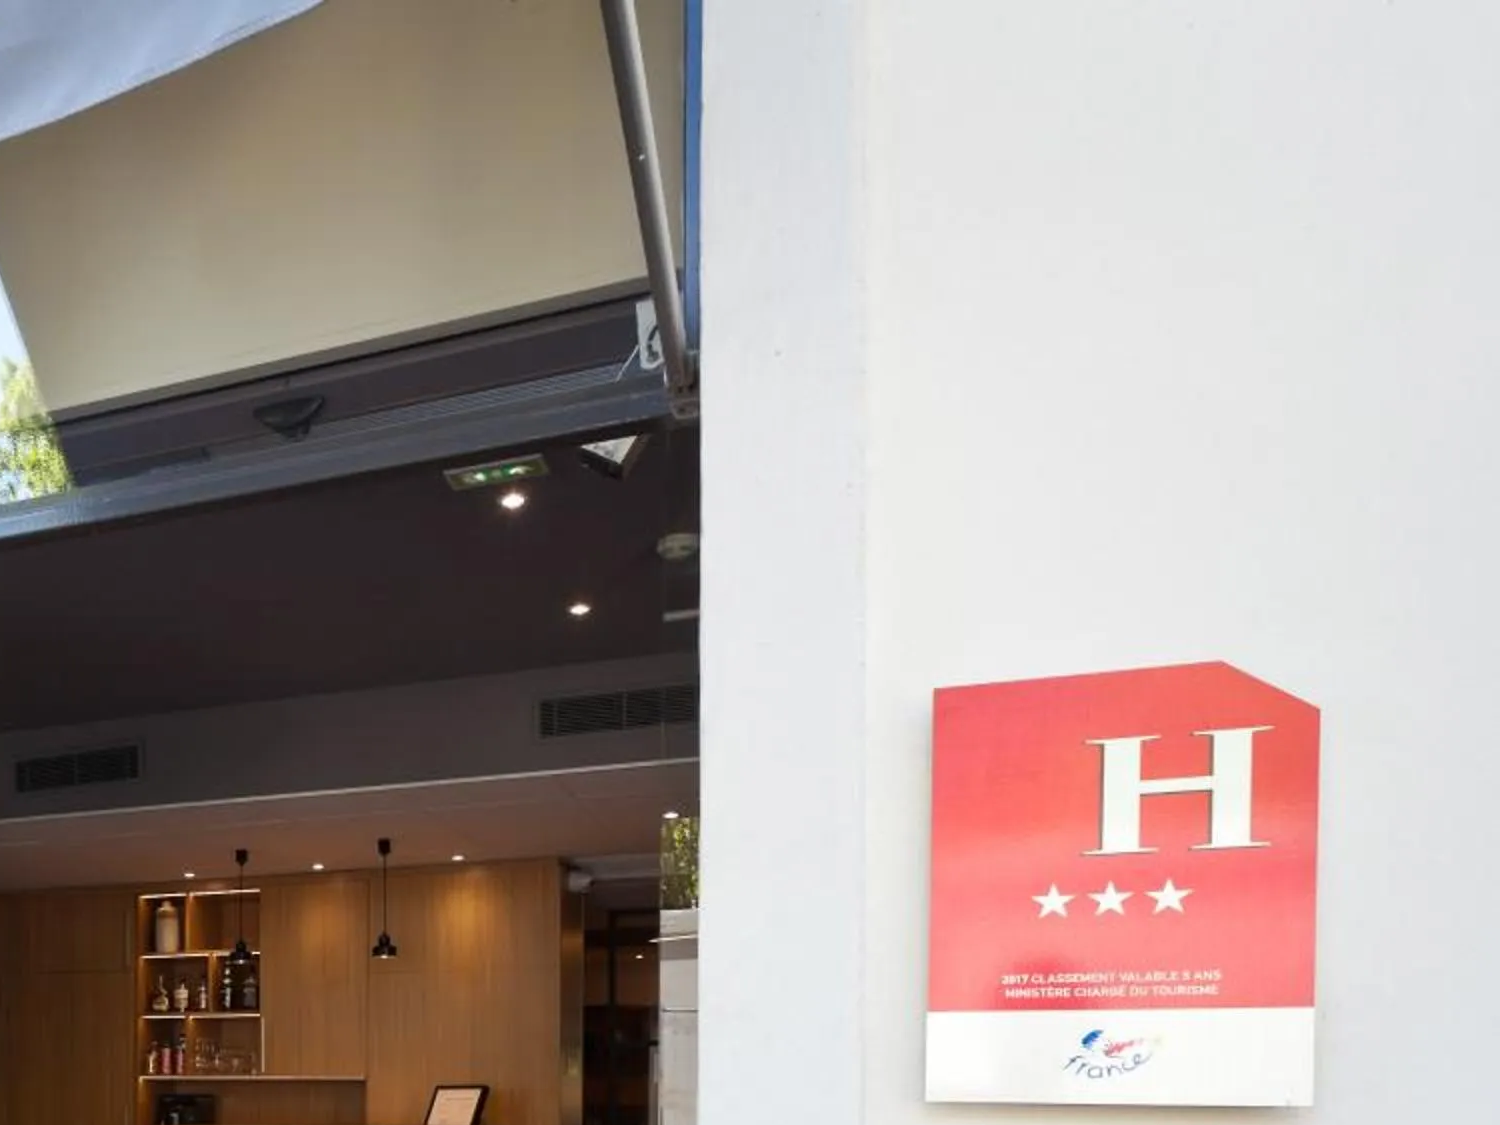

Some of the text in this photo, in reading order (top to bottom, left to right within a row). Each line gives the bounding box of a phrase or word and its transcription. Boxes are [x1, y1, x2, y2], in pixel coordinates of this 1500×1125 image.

[1081, 725, 1275, 855] H
[1030, 972, 1115, 984] CLASSEMENT
[1118, 970, 1178, 983] VALABLE
[1194, 968, 1222, 981] ANS
[1129, 985, 1148, 997] DU
[1152, 984, 1220, 996] TOURISME
